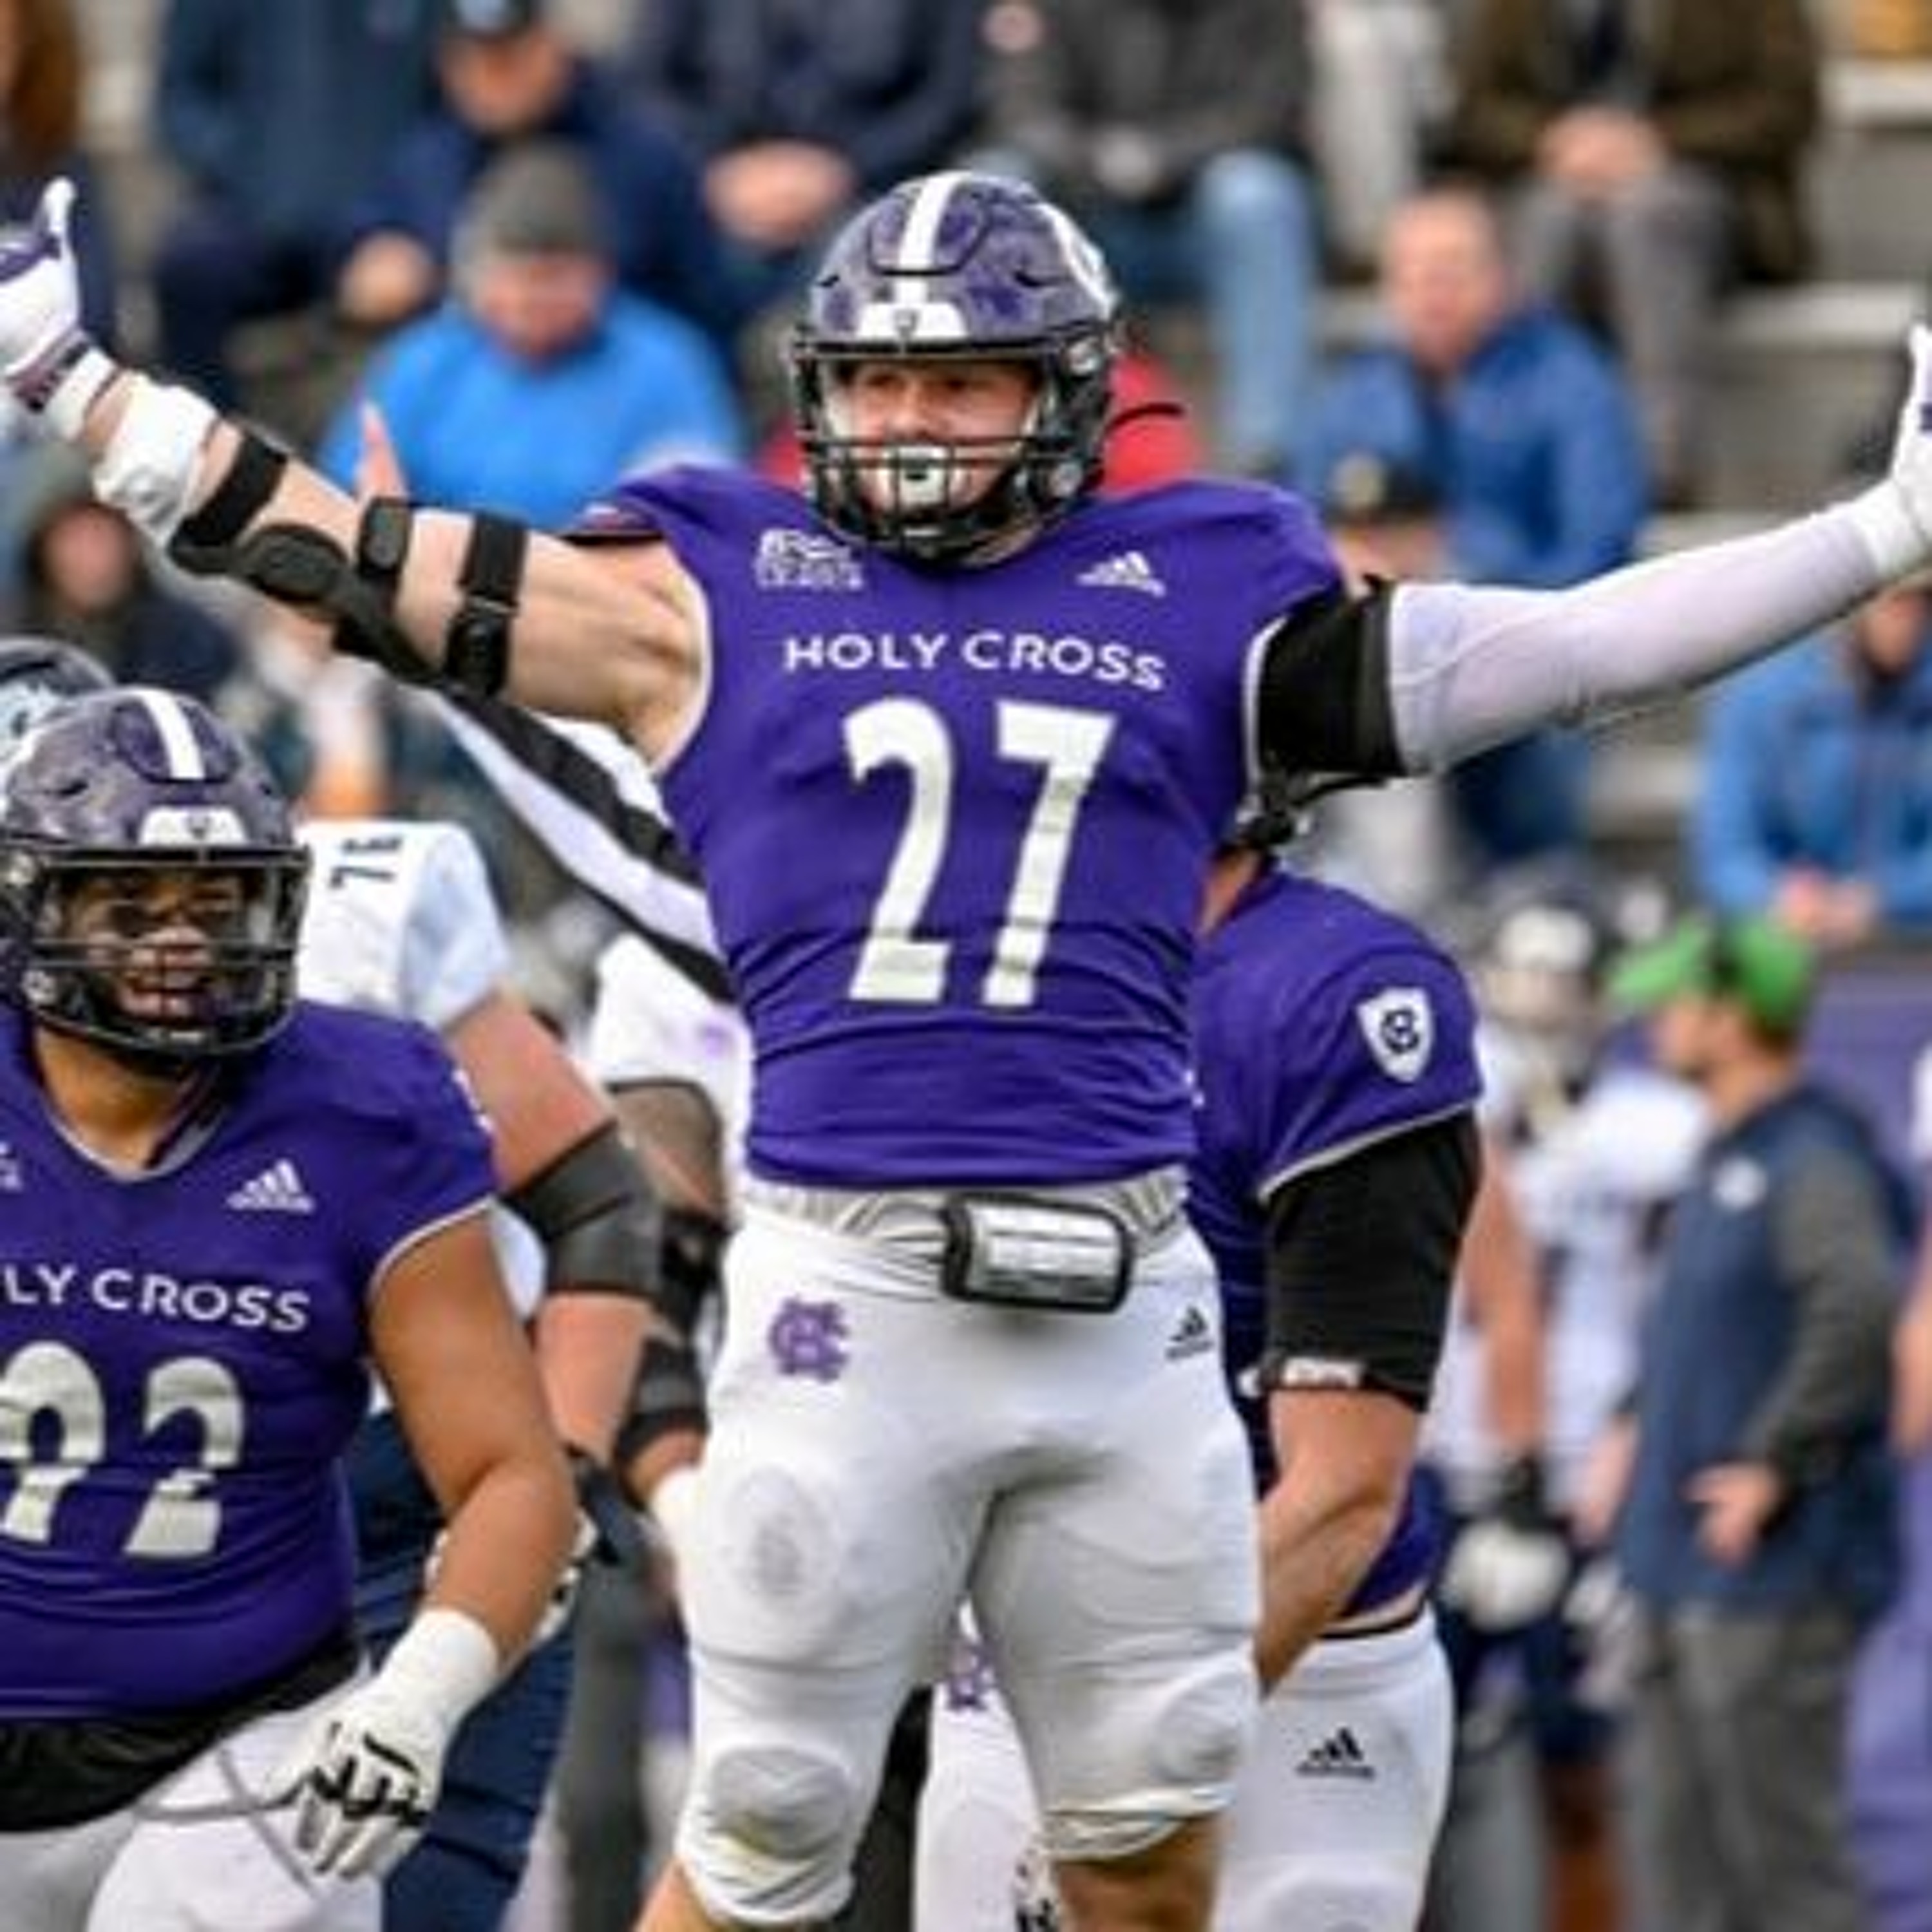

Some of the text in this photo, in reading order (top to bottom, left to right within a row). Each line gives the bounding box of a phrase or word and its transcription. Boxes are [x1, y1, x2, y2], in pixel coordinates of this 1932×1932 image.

[784, 631, 1166, 691] HOLY CROSS
[844, 698, 1117, 1007] 27
[92, 1269, 311, 1332] CROSS
[0, 1341, 245, 1558] 92
